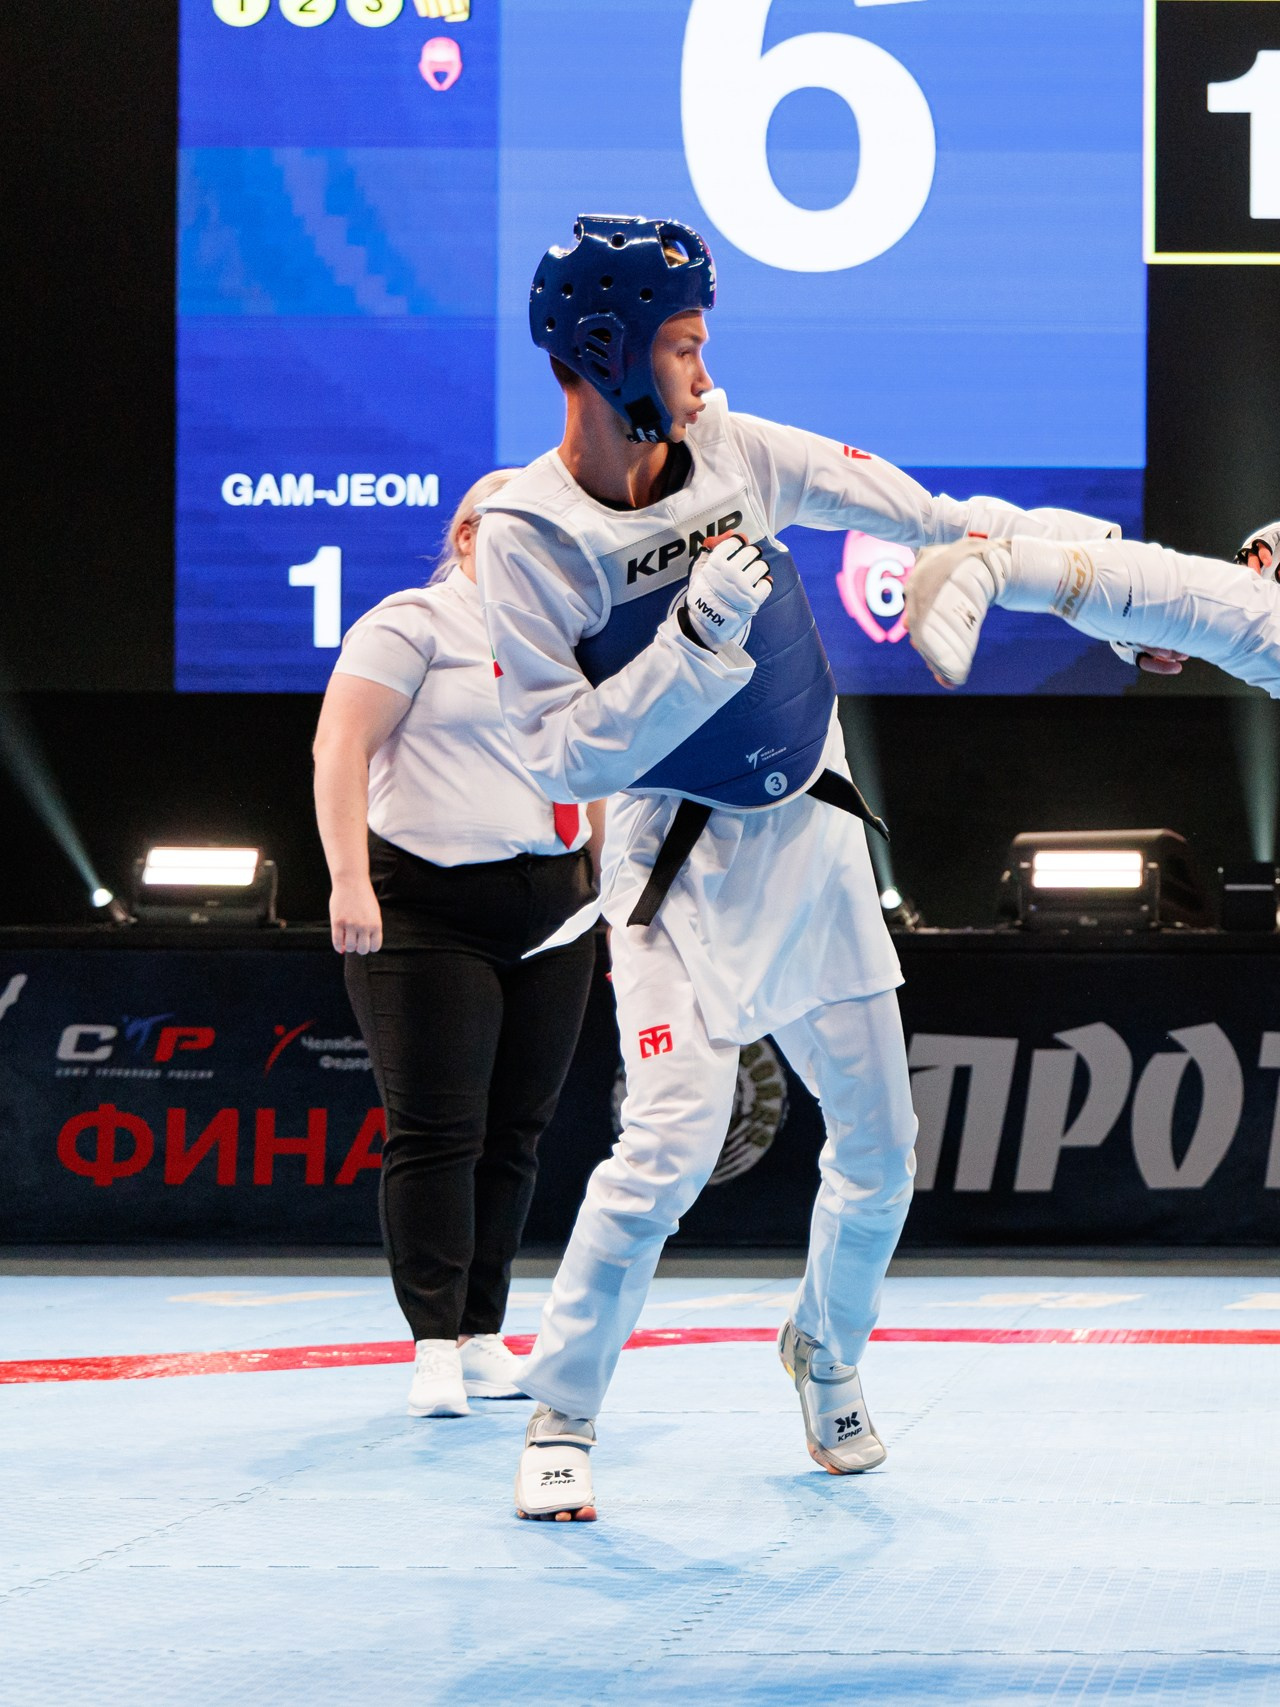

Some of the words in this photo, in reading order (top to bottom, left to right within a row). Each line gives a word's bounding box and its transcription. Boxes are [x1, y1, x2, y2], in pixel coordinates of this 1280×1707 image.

[681, 0, 936, 272] 6
[221, 473, 439, 506] GAM-JEOM
[627, 510, 743, 585] KPNP
[288, 546, 341, 648] 1
[865, 559, 905, 617] 6
[695, 597, 725, 626] KHAN
[771, 776, 782, 791] 3
[838, 1427, 863, 1443] KPNP
[540, 1479, 576, 1487] KPNP
